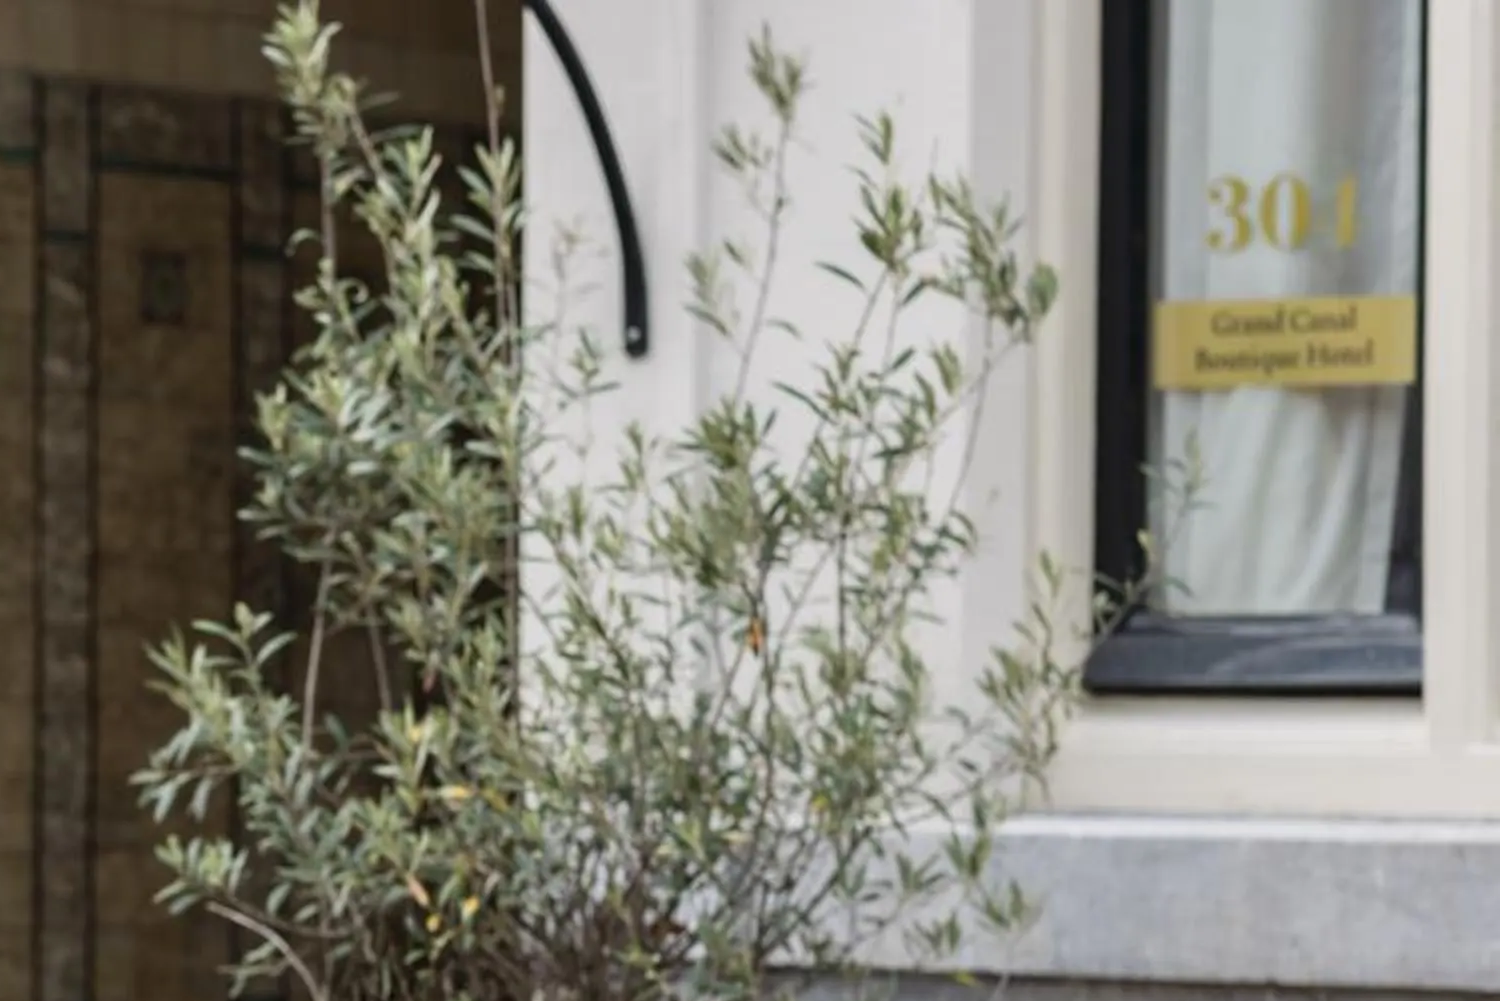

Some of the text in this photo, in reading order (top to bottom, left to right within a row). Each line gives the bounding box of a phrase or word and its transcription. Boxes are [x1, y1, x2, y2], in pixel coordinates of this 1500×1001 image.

[1211, 302, 1357, 337] Grand Canal
[1195, 337, 1375, 378] Boutique Hotel
